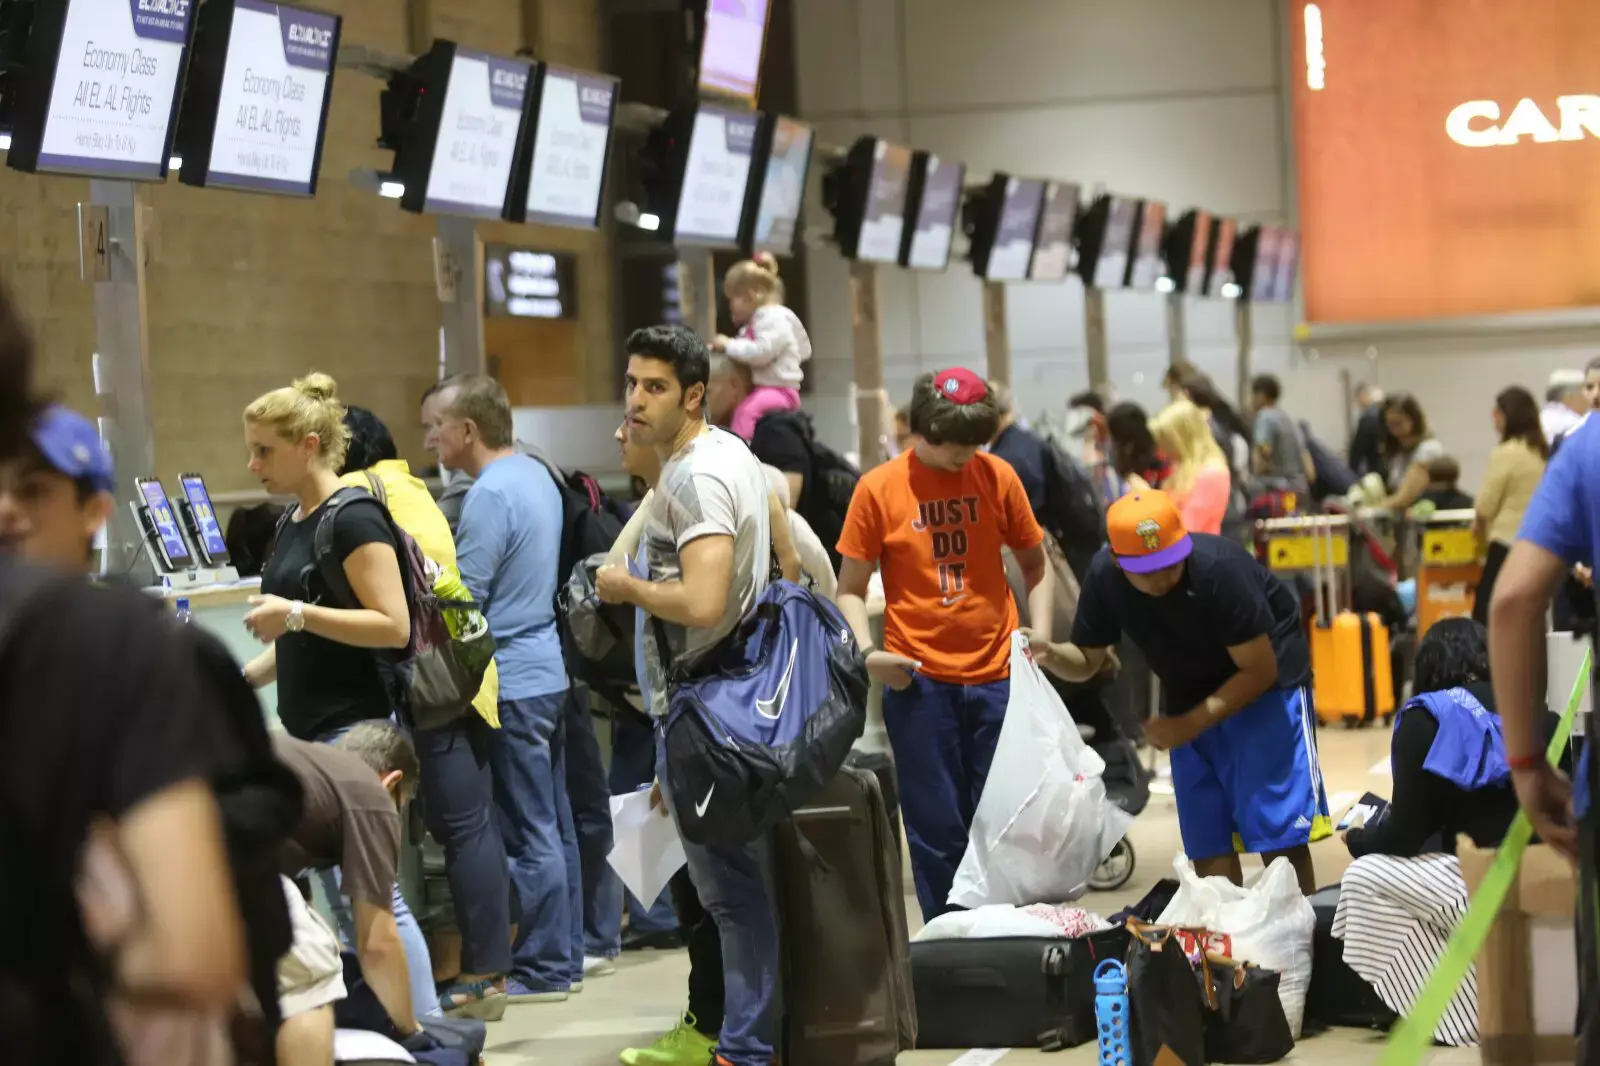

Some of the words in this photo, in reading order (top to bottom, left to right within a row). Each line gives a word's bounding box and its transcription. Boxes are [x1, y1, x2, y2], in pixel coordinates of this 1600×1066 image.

[83, 41, 130, 78] Economy
[130, 48, 157, 76] Class
[73, 80, 88, 107] All
[88, 82, 101, 109] EL
[104, 84, 117, 111] AL
[120, 86, 152, 120] Flights
[243, 68, 280, 103] Economy
[282, 75, 305, 102] Class
[236, 104, 247, 129] All
[248, 106, 258, 131] EL
[260, 108, 272, 133] AL
[274, 110, 301, 142] Flights
[97, 219, 106, 265] 4
[911, 496, 980, 532] JUST
[932, 529, 968, 561] DO
[937, 560, 967, 594] IT
